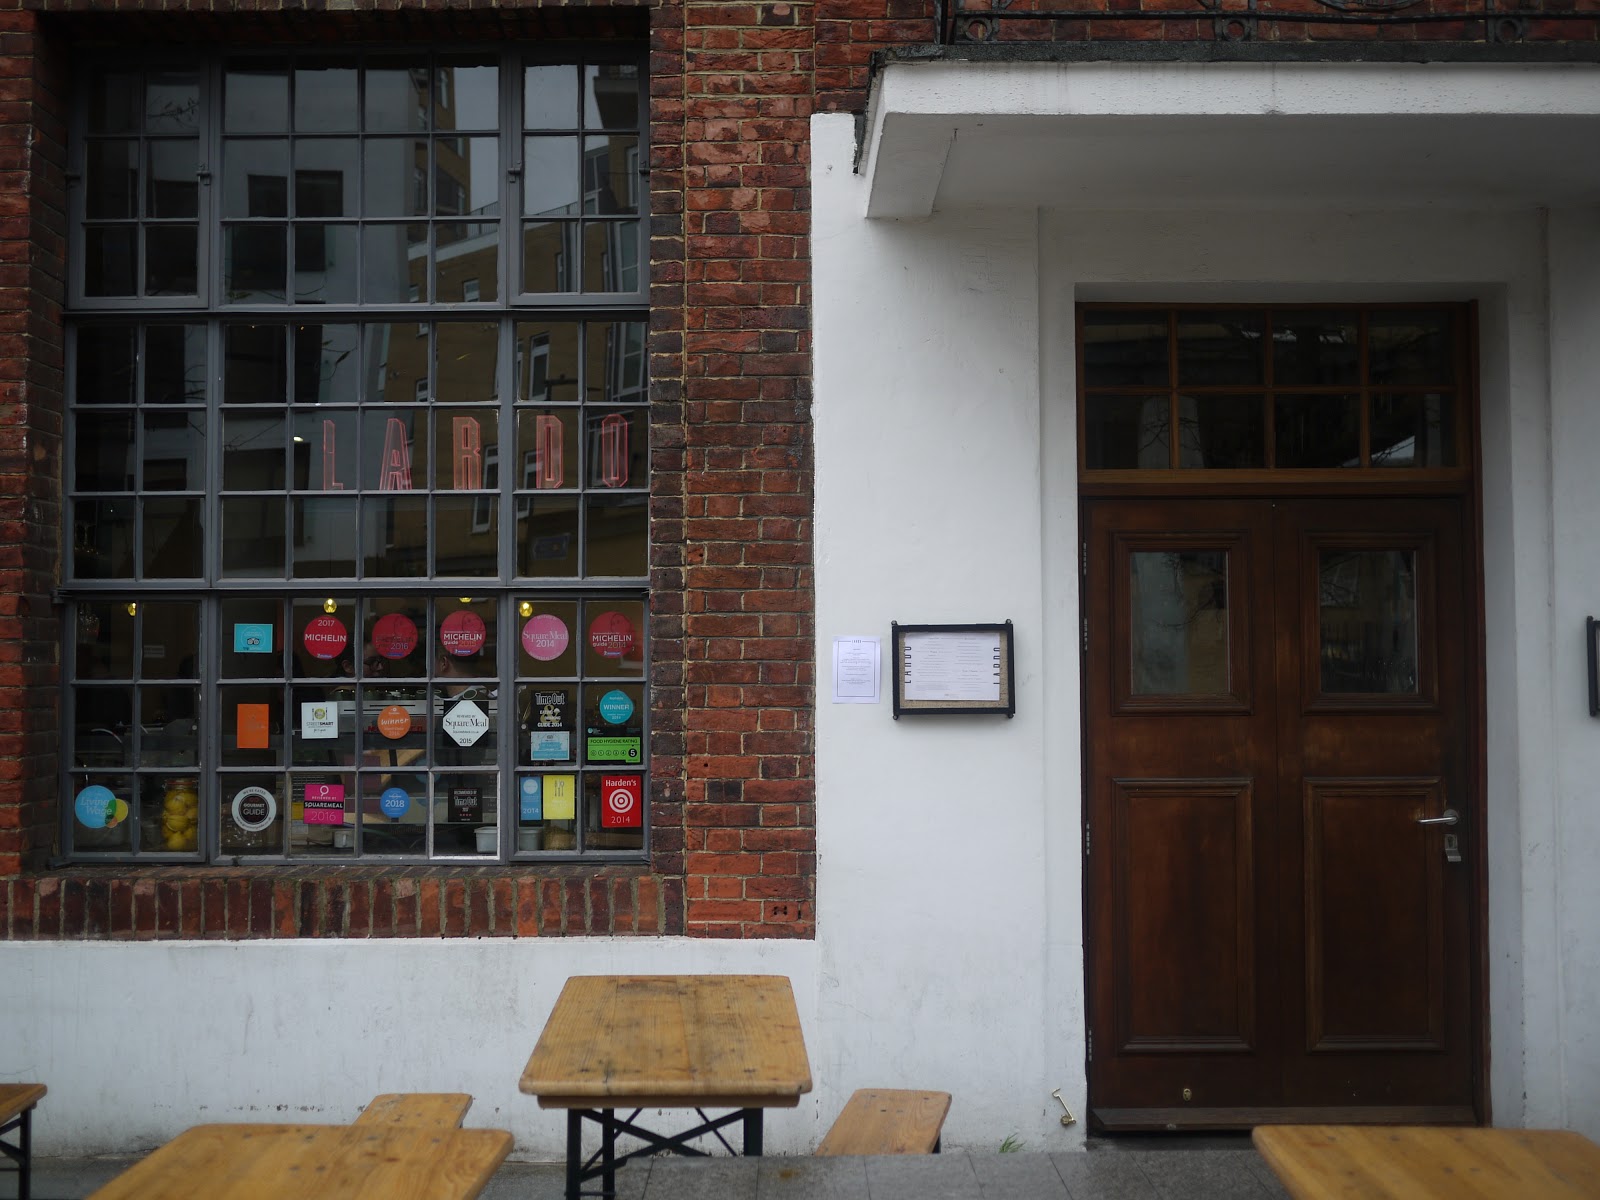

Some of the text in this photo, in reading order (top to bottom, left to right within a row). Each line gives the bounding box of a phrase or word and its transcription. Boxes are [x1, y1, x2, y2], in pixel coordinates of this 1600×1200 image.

[323, 414, 629, 490] LARDO
[317, 619, 335, 627] 2017
[304, 633, 347, 642] MICHELIN
[592, 634, 632, 642] MICHELIN
[390, 642, 409, 650] 2016
[536, 640, 555, 648] 2014
[607, 641, 627, 649] 2014
[605, 778, 637, 787] Harden's
[80, 796, 109, 807] Living
[304, 801, 343, 809] SQUAREMEAL
[385, 799, 405, 808] 2018
[86, 805, 113, 816] Wage
[242, 808, 266, 816] GUIDE
[311, 811, 337, 822] 2016
[611, 816, 631, 824] 2014
